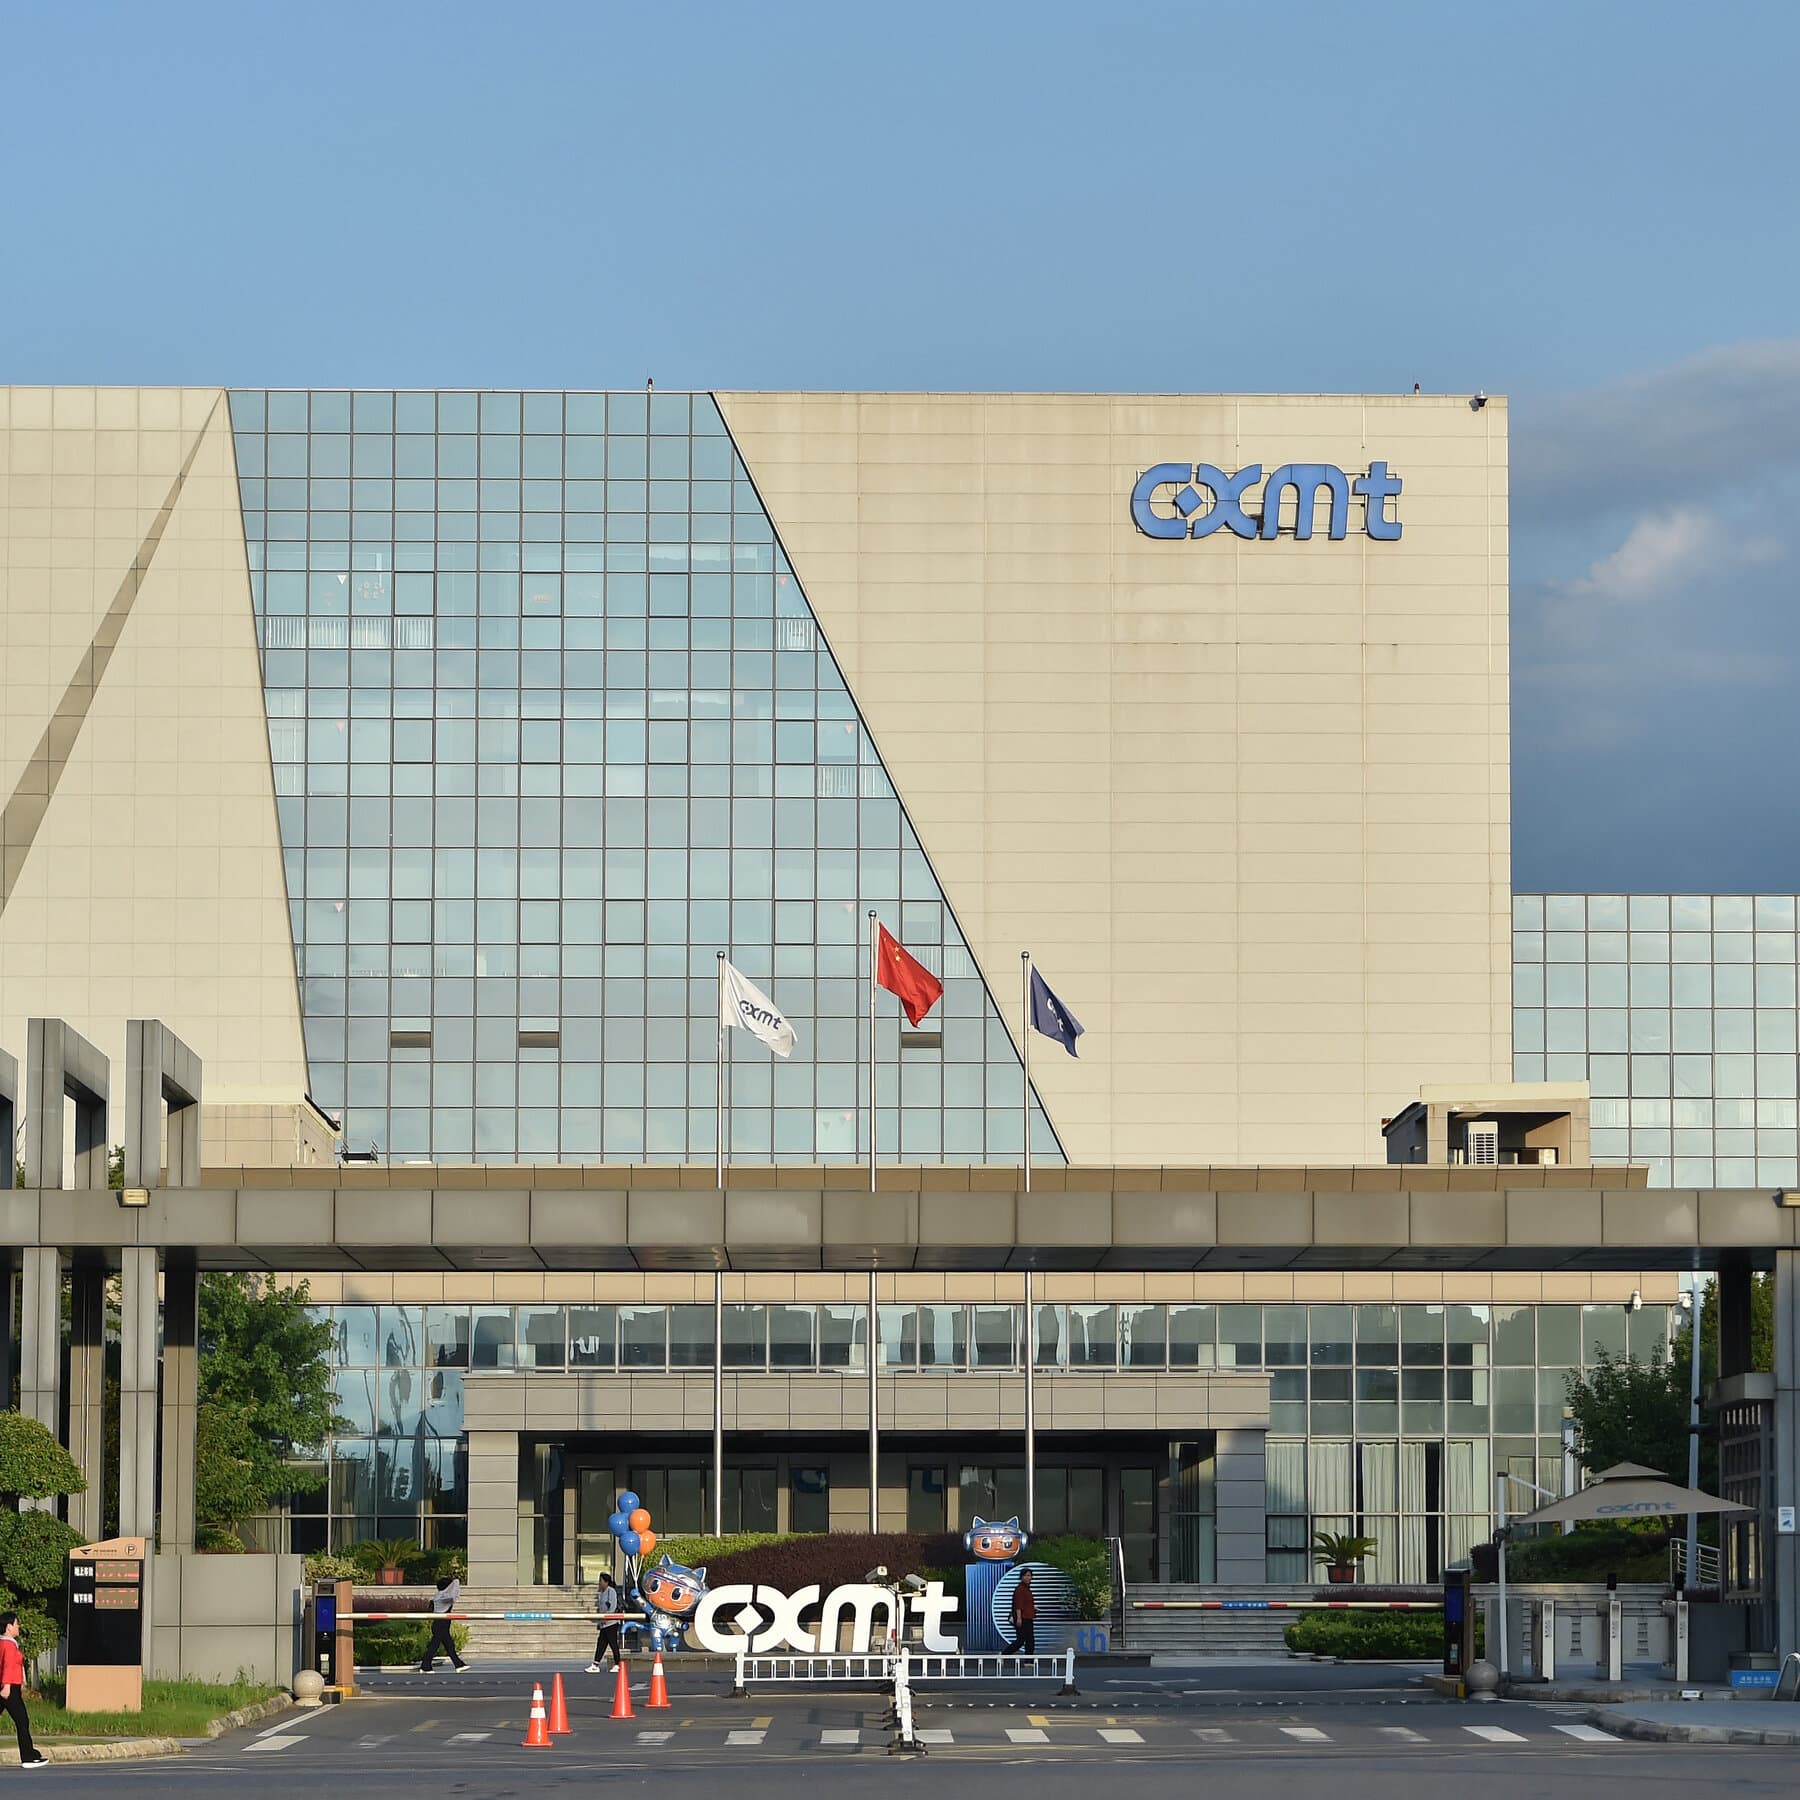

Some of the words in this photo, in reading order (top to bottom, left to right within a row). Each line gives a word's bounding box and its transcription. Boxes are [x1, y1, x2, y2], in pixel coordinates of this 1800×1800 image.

[1130, 461, 1403, 541] cxmt
[739, 999, 782, 1030] cxmt
[694, 1581, 959, 1653] cxmt
